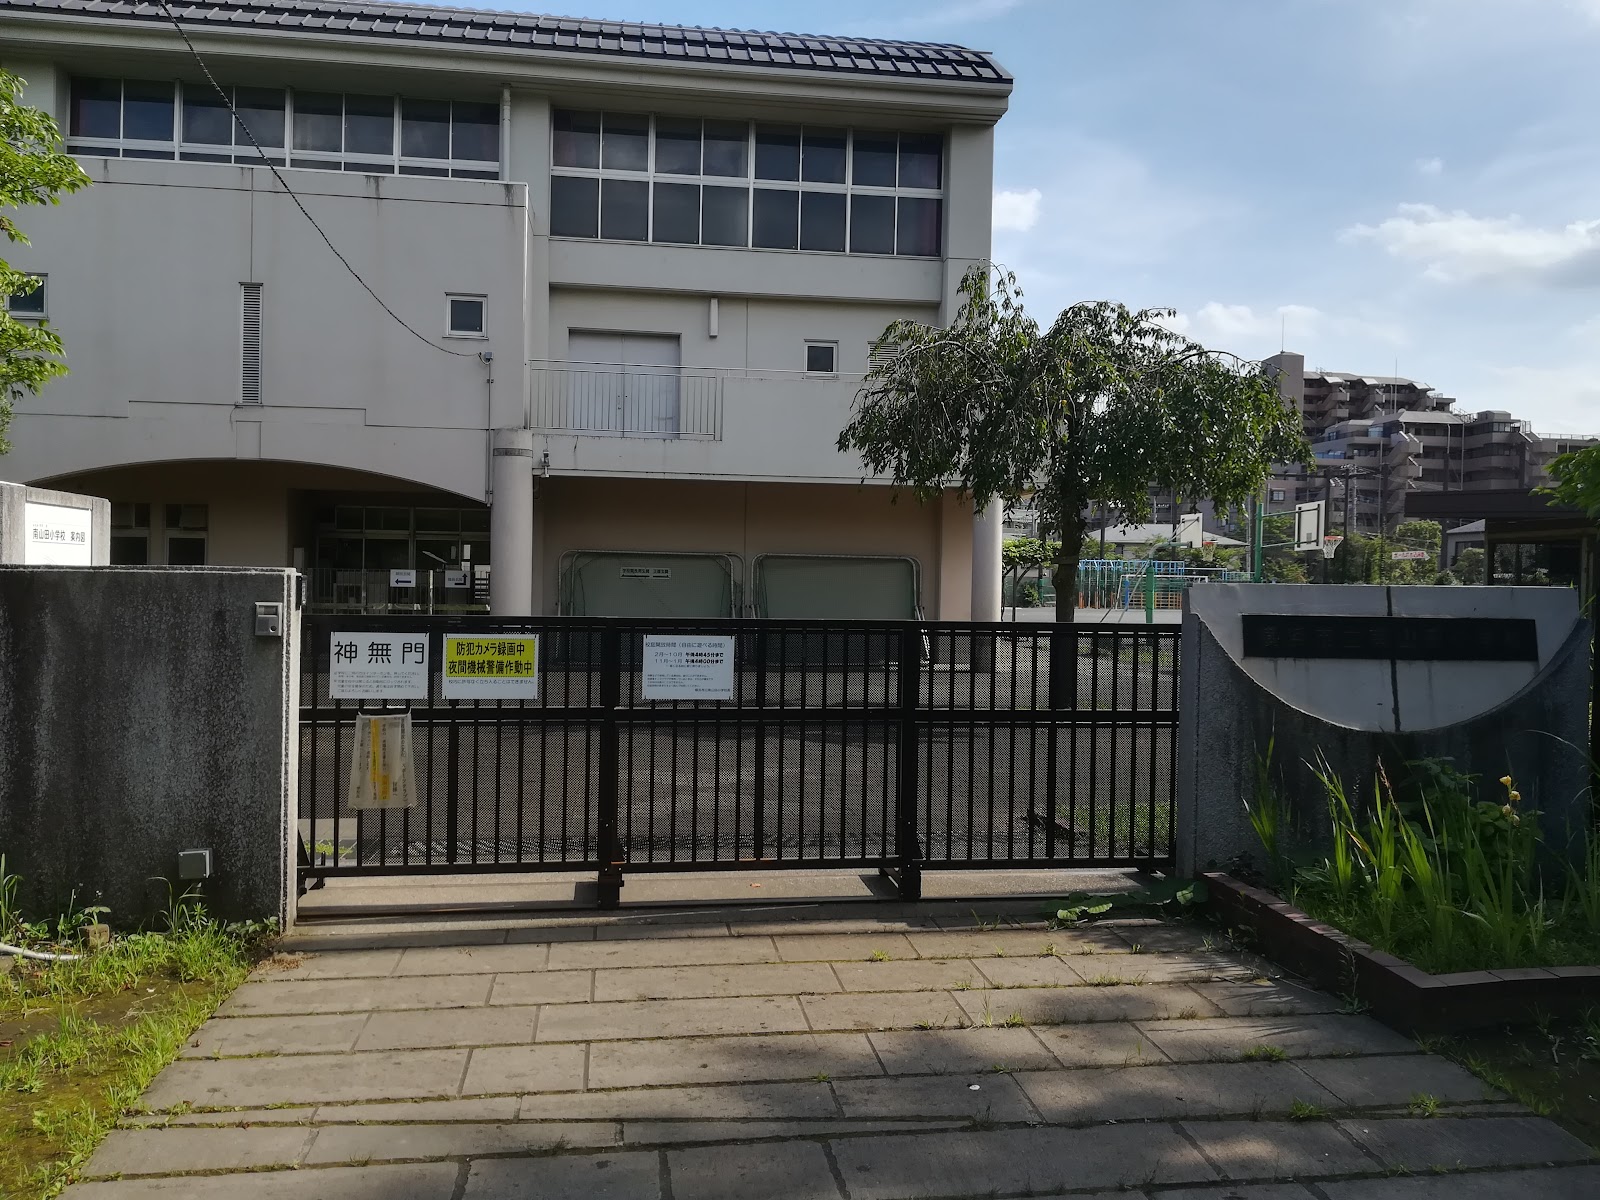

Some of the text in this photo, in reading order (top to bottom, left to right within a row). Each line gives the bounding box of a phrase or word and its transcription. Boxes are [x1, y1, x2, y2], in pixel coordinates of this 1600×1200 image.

[32, 528, 86, 542] 南山田小学校 案内図
[334, 640, 425, 664] 神無門
[456, 641, 525, 656] 防犯カメラ録画中
[448, 659, 532, 675] 夜間機械警備作動中
